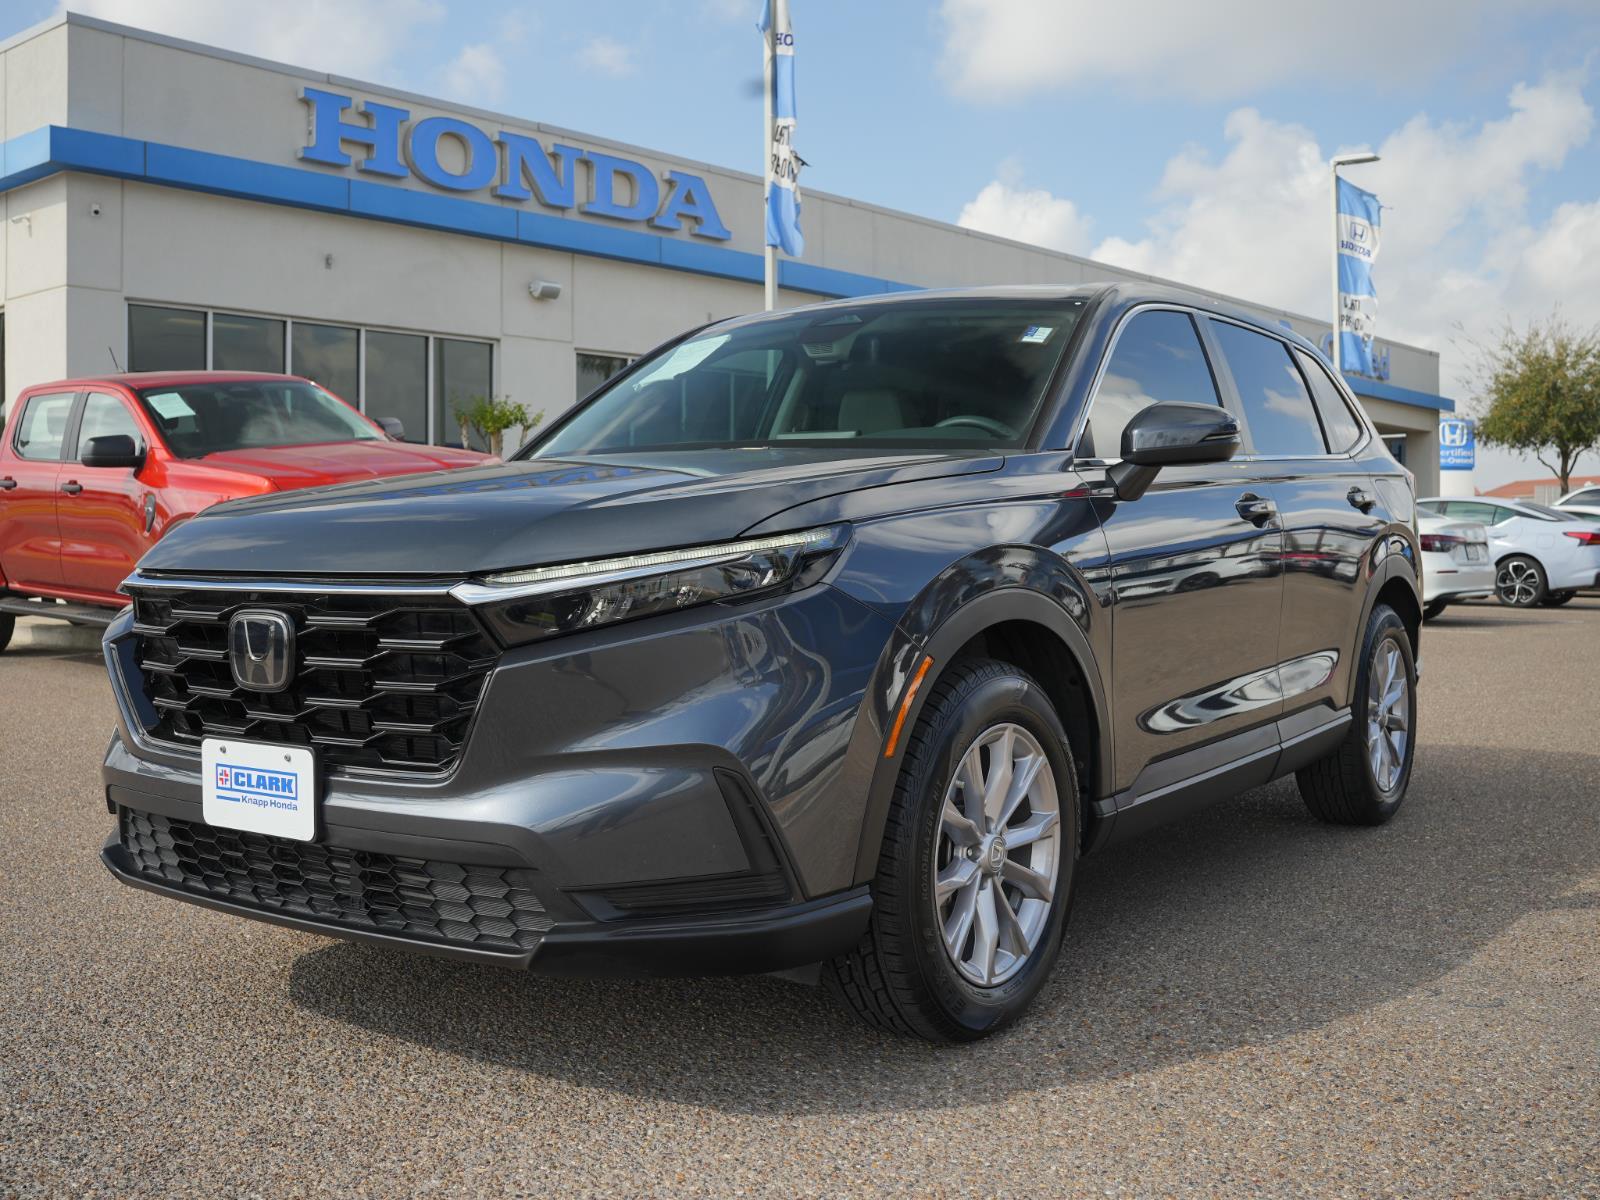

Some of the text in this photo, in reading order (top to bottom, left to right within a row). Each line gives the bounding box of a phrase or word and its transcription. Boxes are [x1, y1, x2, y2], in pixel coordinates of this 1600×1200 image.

[298, 87, 731, 241] HONDA
[1440, 448, 1473, 456] ertified
[233, 771, 294, 793] CLARK
[241, 795, 298, 811] Knapp Honda
